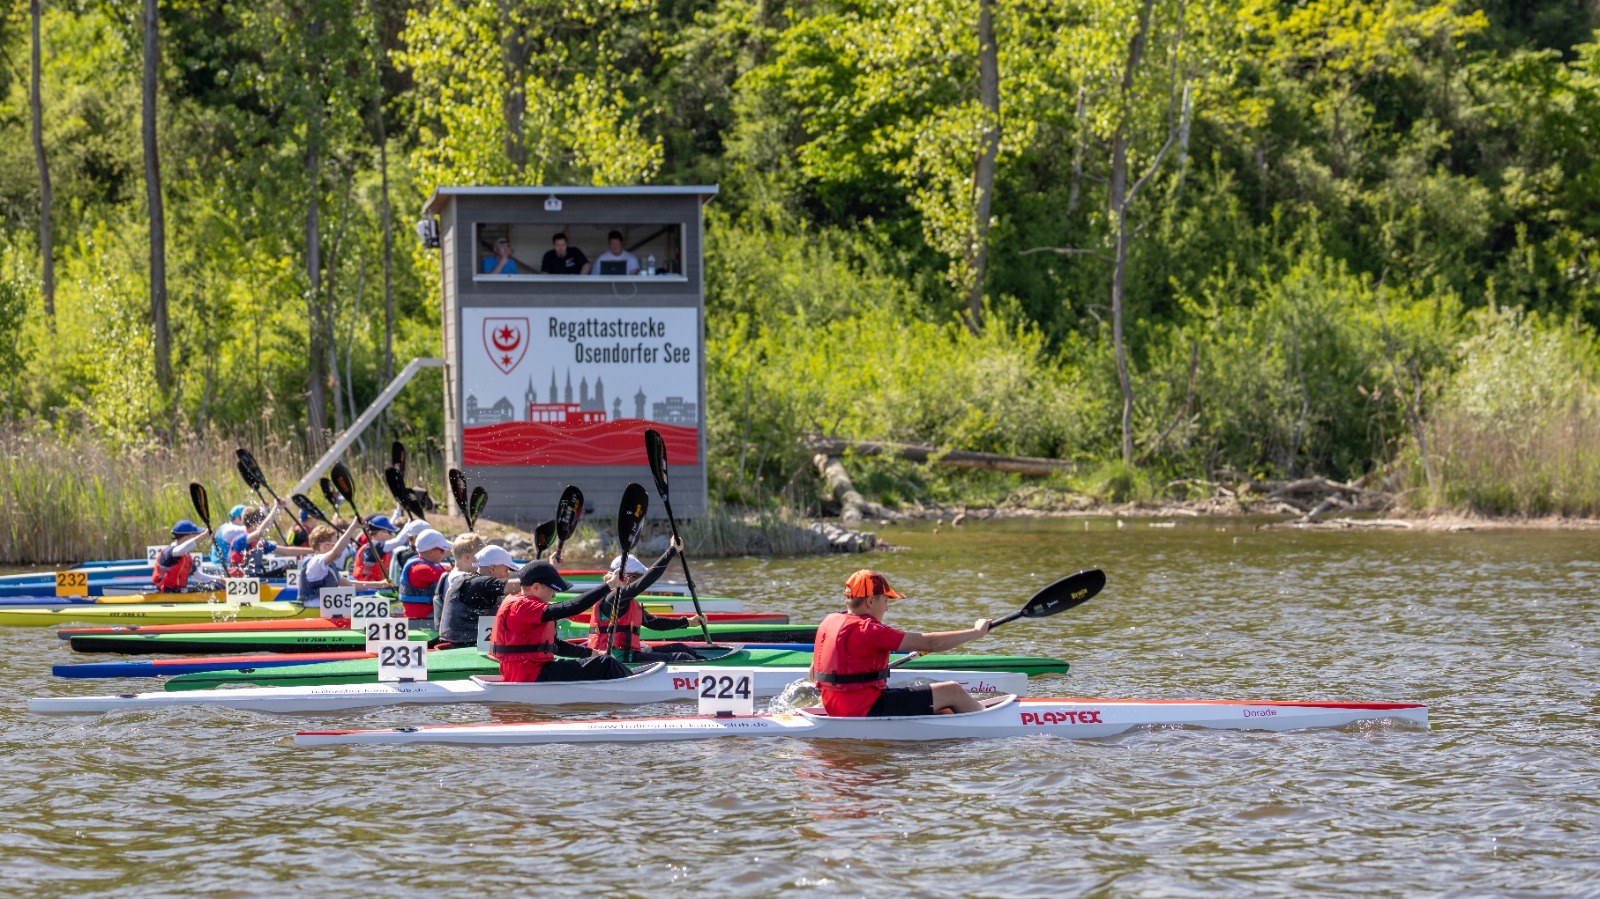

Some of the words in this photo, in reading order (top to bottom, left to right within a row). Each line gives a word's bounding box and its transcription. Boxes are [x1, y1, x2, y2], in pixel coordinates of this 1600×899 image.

[549, 317, 665, 342] Regattastrecke
[575, 342, 659, 363] Osendorfer
[664, 342, 690, 363] See
[57, 573, 87, 587] 232
[228, 581, 259, 595] 230
[323, 593, 353, 609] 665
[353, 601, 388, 618] 226
[368, 622, 407, 641] 218
[381, 645, 423, 667] 231
[701, 675, 751, 700] 224
[1243, 708, 1277, 718] Dorade
